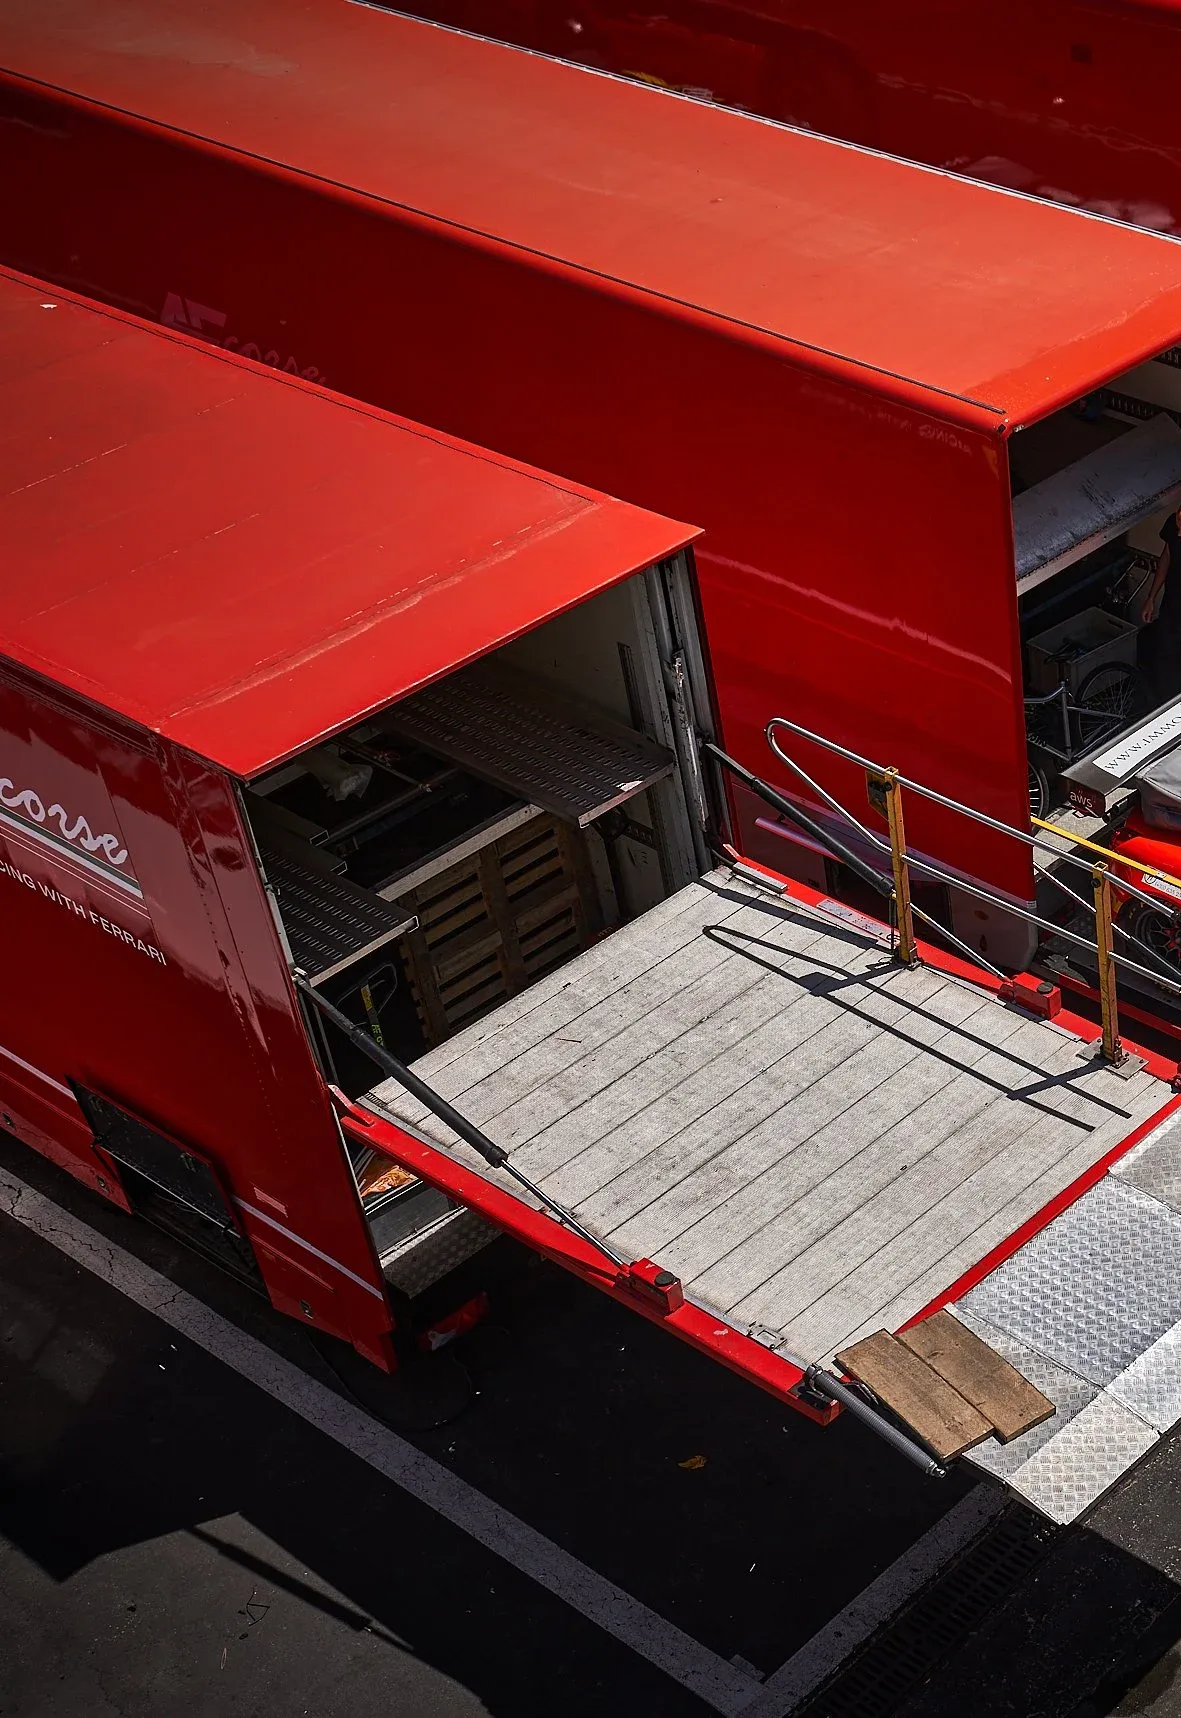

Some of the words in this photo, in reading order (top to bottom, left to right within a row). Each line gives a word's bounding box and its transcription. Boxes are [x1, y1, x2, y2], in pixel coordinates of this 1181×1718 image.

[0, 778, 129, 865] corse
[1069, 791, 1094, 808] aws
[38, 880, 87, 919] WITH
[89, 909, 167, 966] FERRARI
